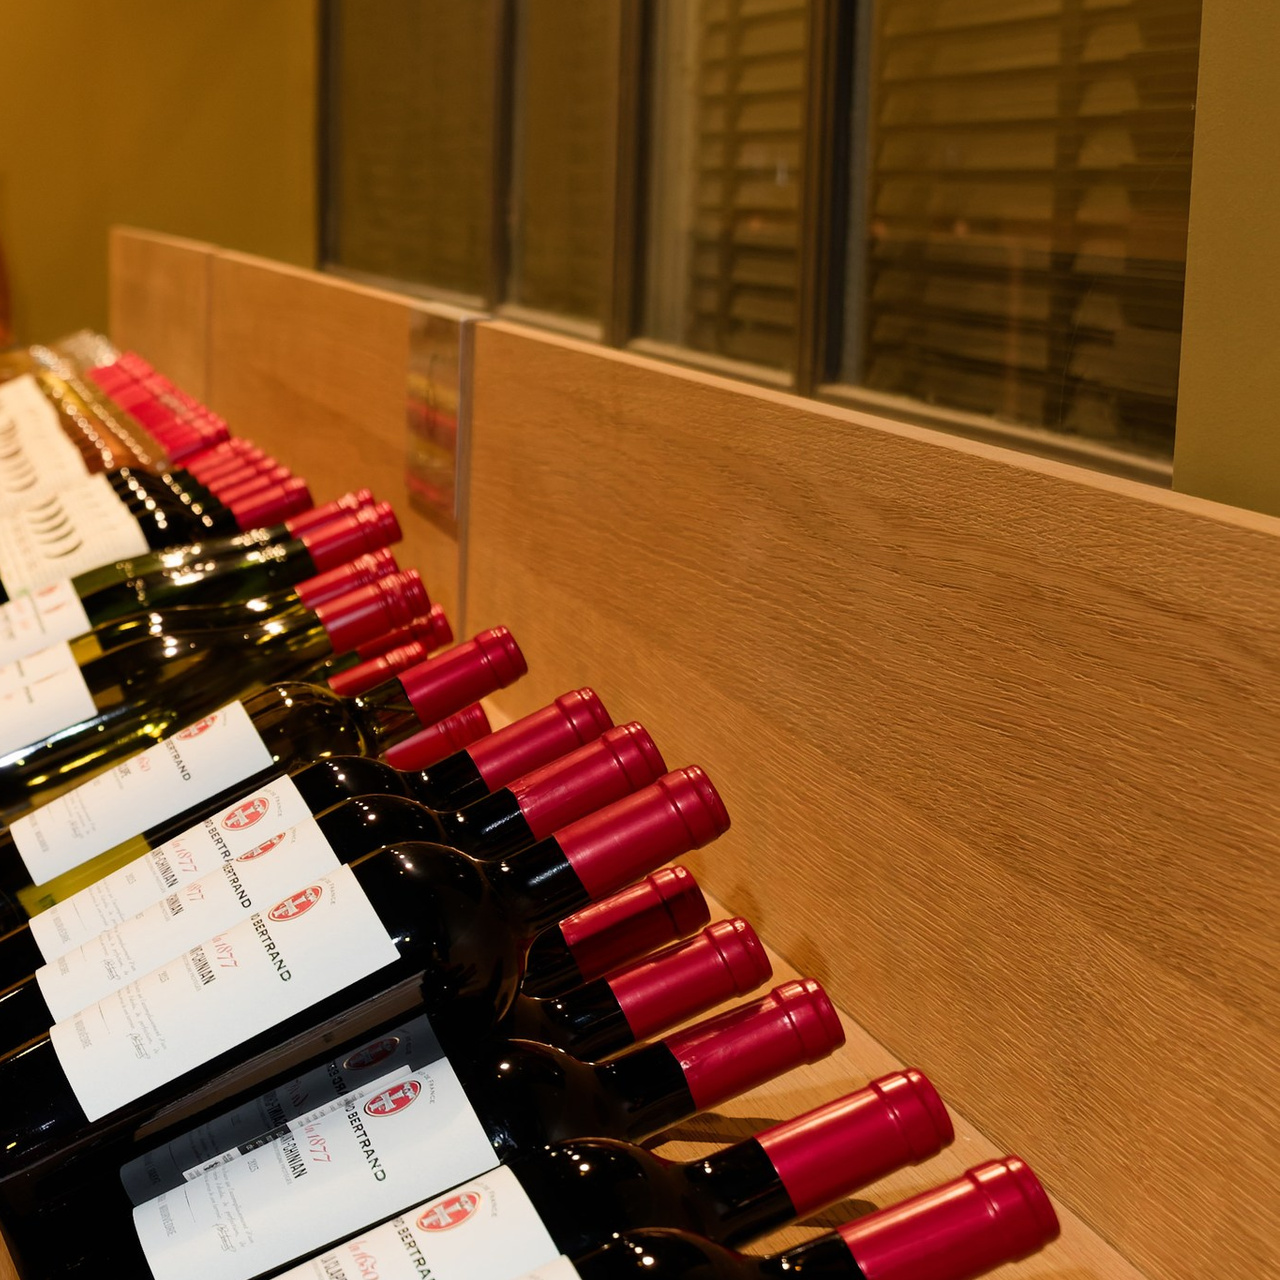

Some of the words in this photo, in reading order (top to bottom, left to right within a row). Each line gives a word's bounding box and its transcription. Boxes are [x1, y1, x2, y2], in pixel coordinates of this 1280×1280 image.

[150, 845, 179, 888] AINT-CHINIAN
[171, 844, 200, 877] 1877
[188, 944, 217, 986] NT-CHINIAN
[210, 938, 241, 974] 1877
[252, 917, 293, 983] BERTRAND
[278, 1131, 308, 1180] AINT-CHINIAN
[302, 1129, 335, 1168] 1877
[346, 1110, 388, 1184] BERTRAND
